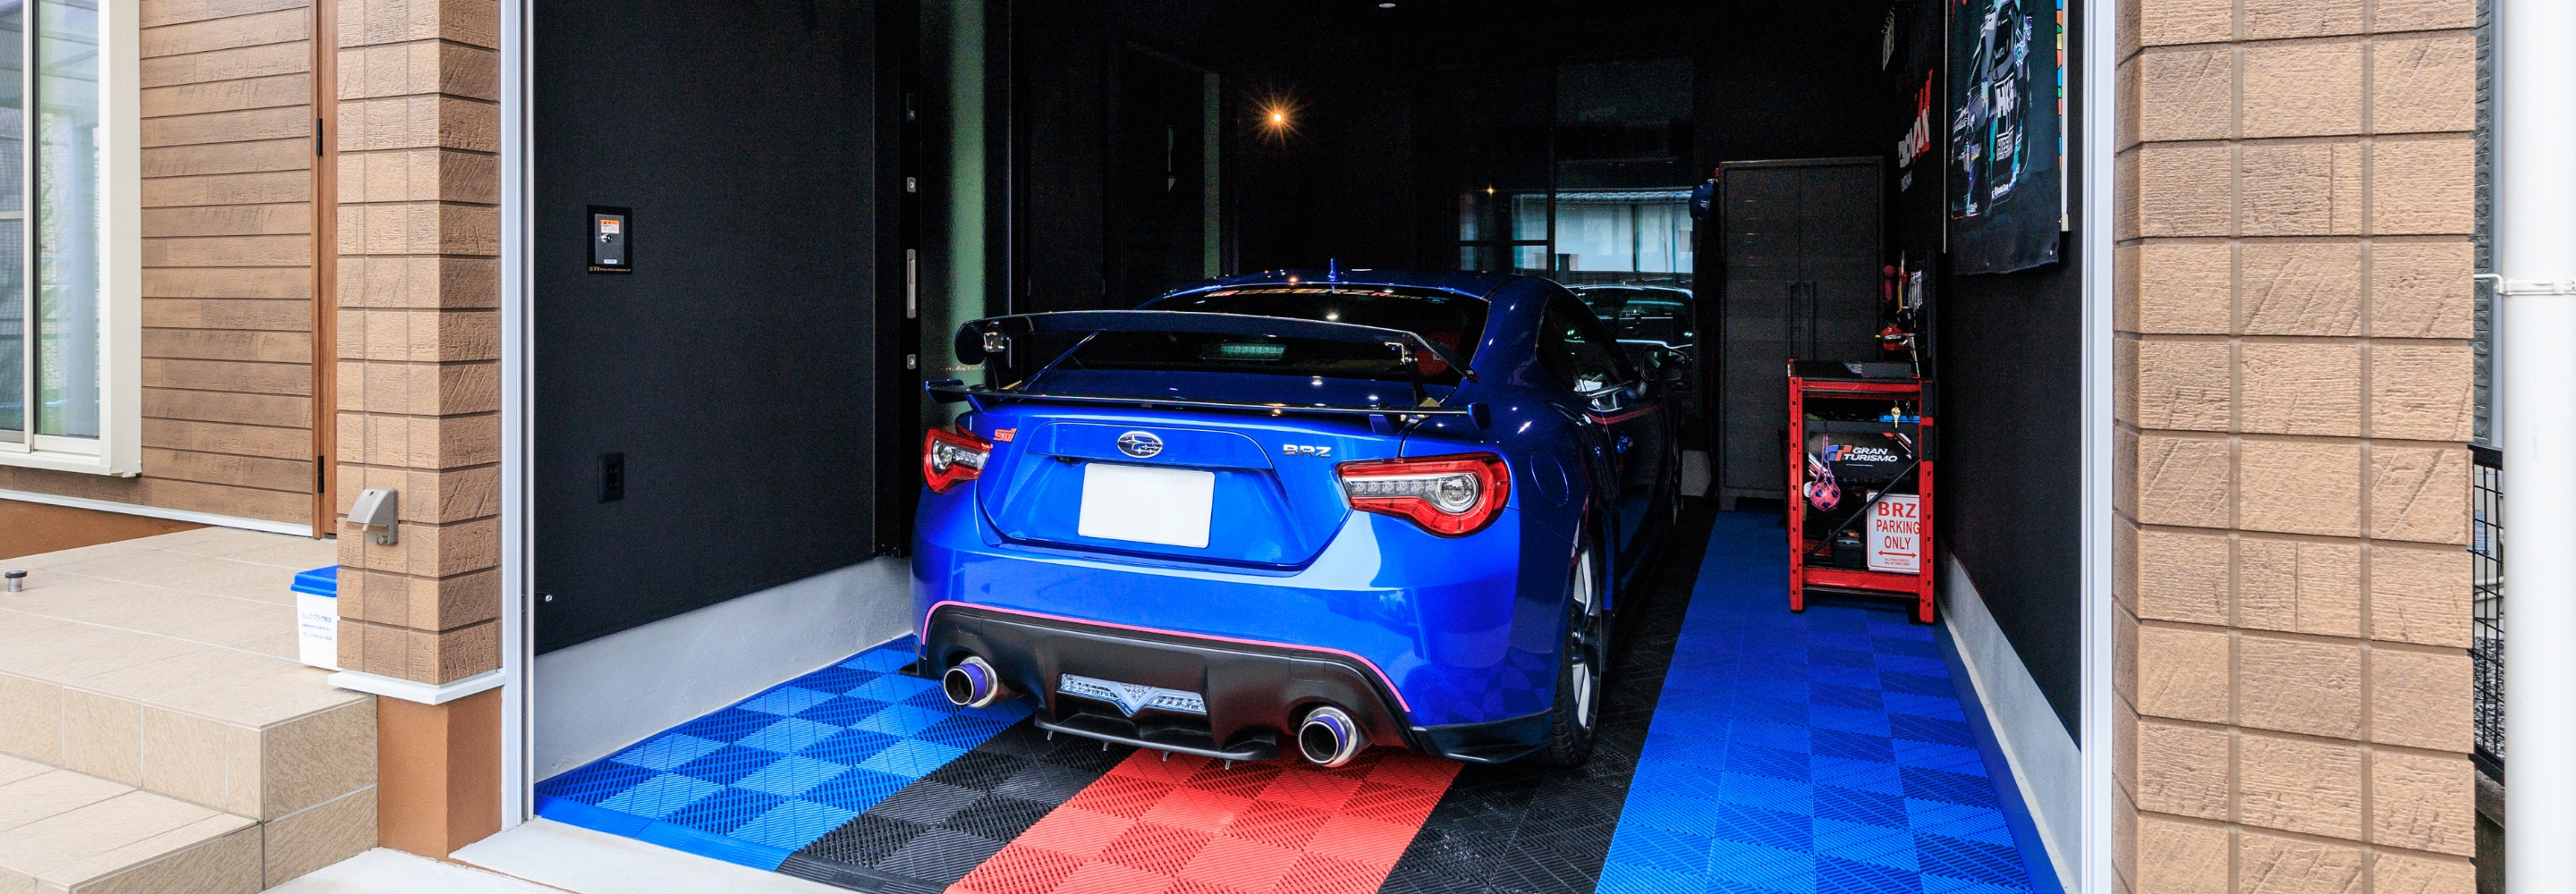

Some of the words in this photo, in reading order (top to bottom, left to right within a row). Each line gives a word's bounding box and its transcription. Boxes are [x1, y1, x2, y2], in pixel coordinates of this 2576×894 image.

[1283, 443, 1332, 458] BRZ
[1843, 453, 1898, 462] TURISMO
[1852, 446, 1888, 455] GRAN
[1877, 501, 1917, 519] BRZ
[1876, 519, 1920, 535] PARKING
[1884, 536, 1911, 551] ONLY
